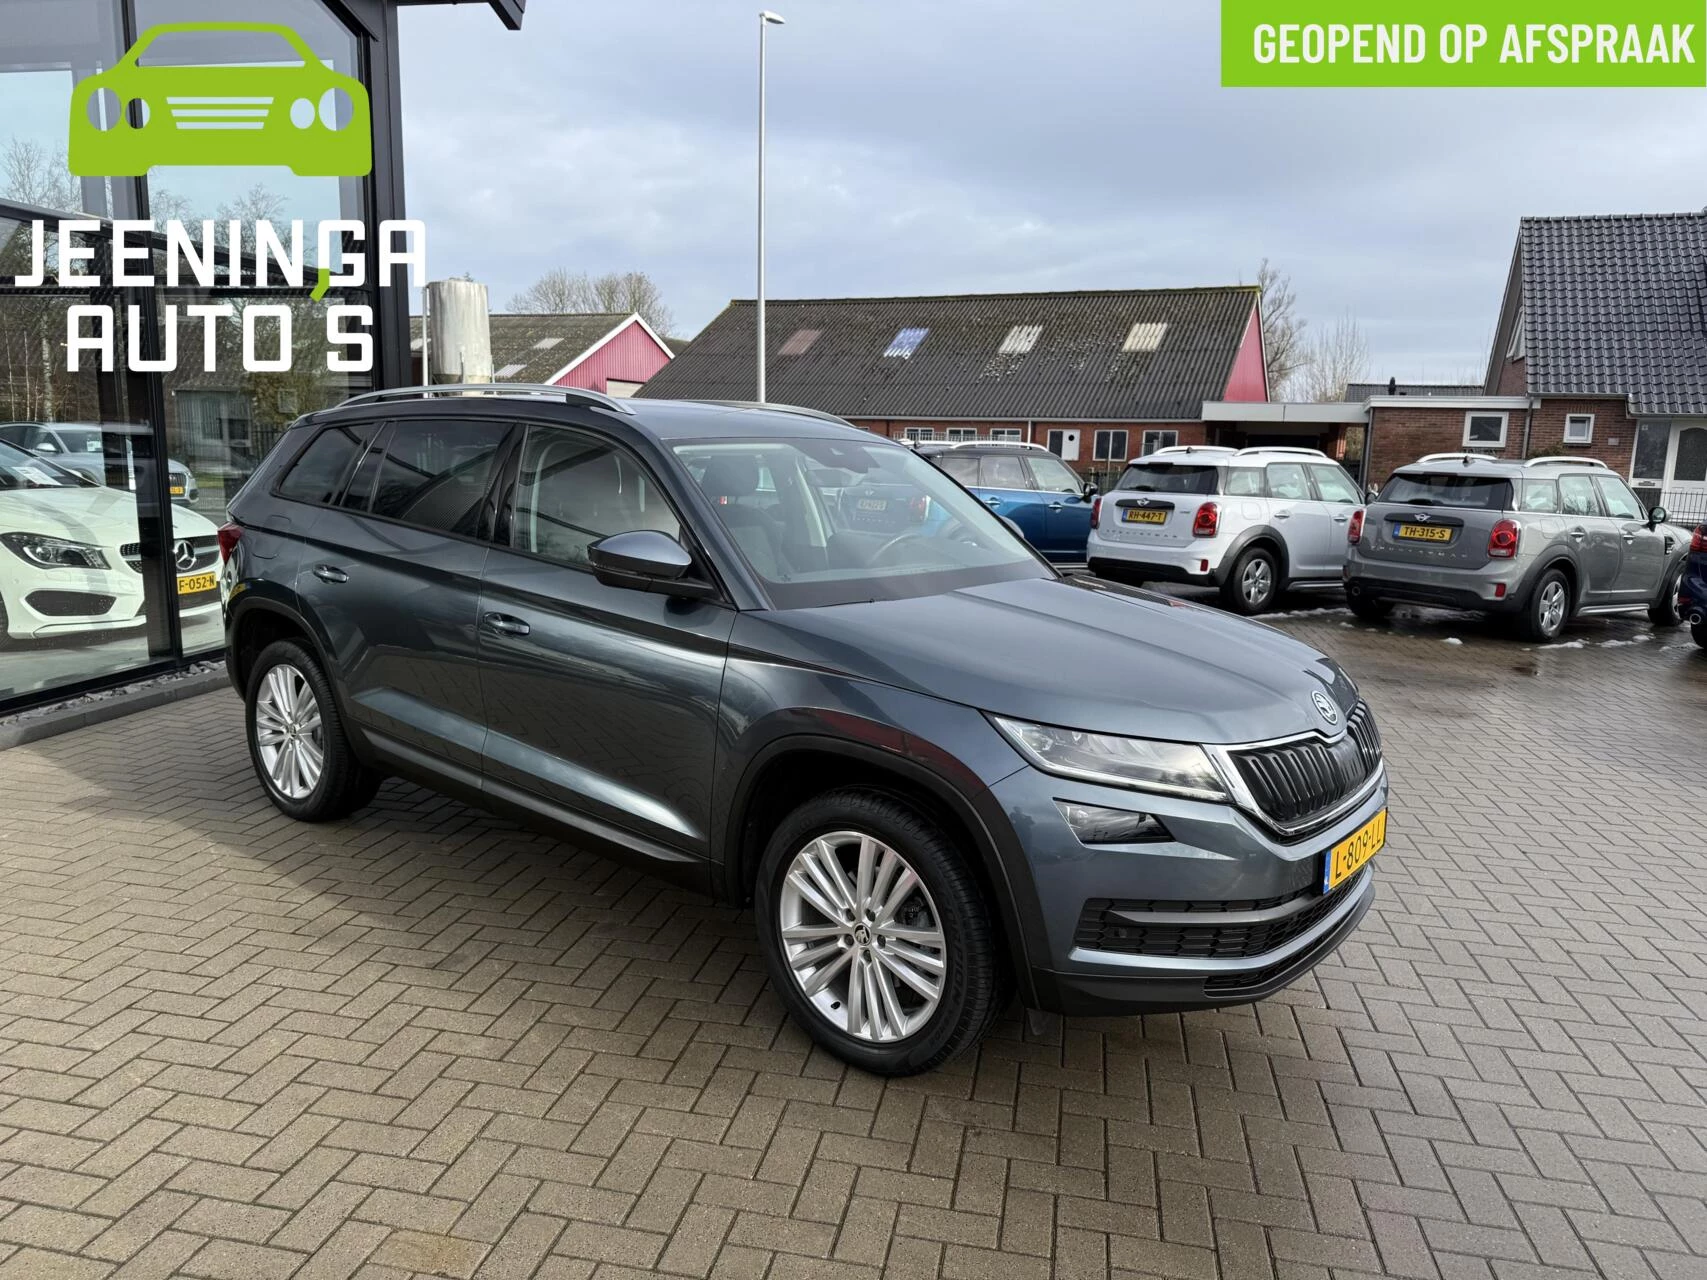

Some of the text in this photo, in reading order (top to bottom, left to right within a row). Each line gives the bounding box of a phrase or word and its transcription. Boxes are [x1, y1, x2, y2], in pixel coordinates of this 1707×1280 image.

[1128, 510, 1162, 521] RH-447-T
[1403, 526, 1446, 539] TH-315-S
[1335, 820, 1381, 880] L-809-LL
